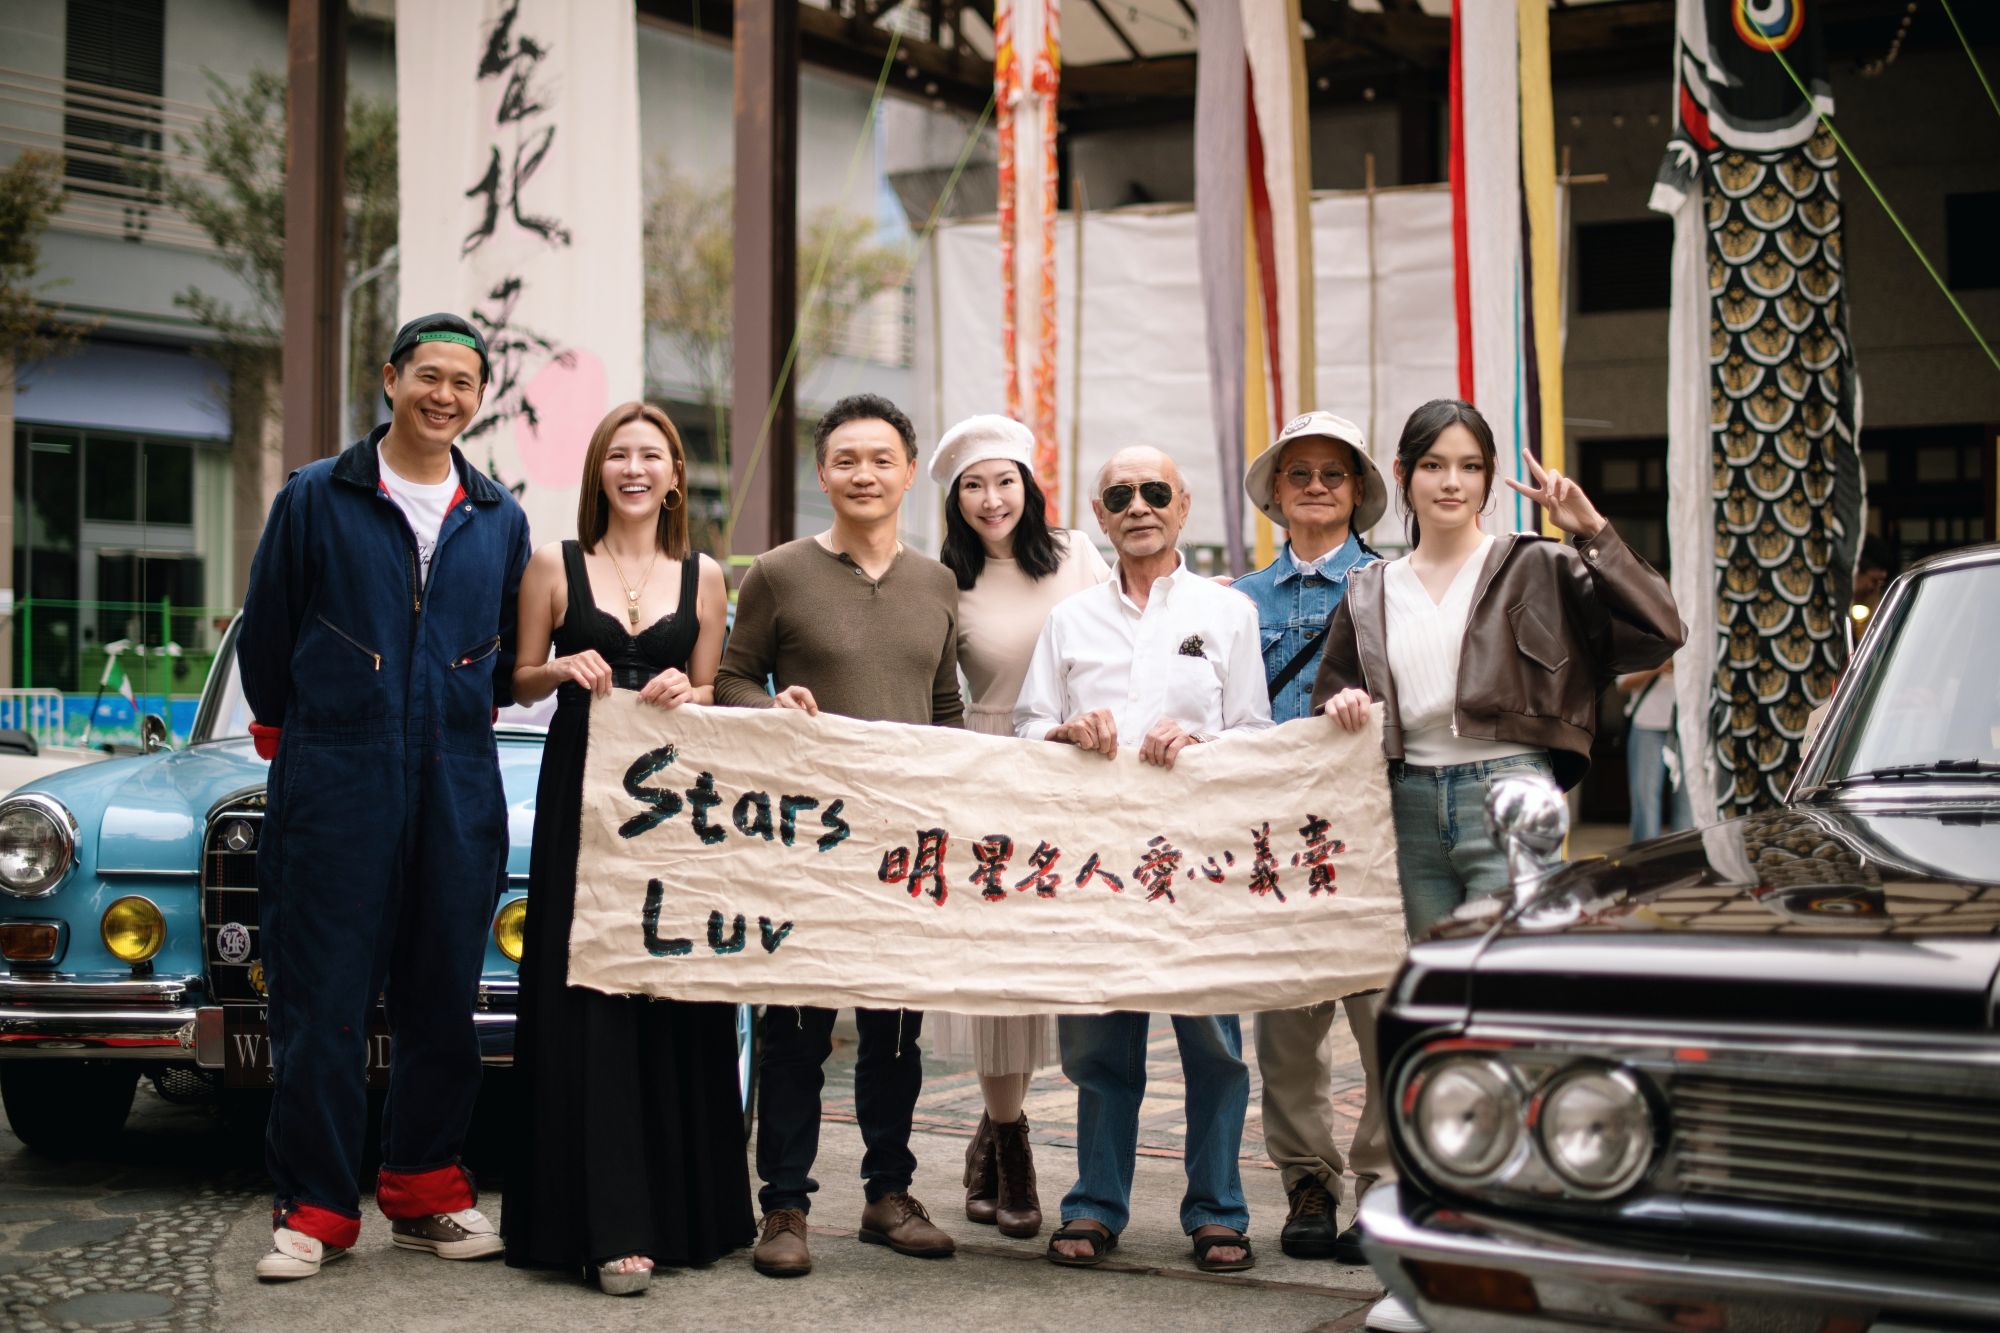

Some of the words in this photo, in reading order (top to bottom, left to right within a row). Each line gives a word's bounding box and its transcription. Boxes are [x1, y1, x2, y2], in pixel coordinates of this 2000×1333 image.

[618, 743, 851, 852] Stars
[878, 813, 1346, 907] 明星名人愛心義賣
[642, 878, 794, 957] Luv
